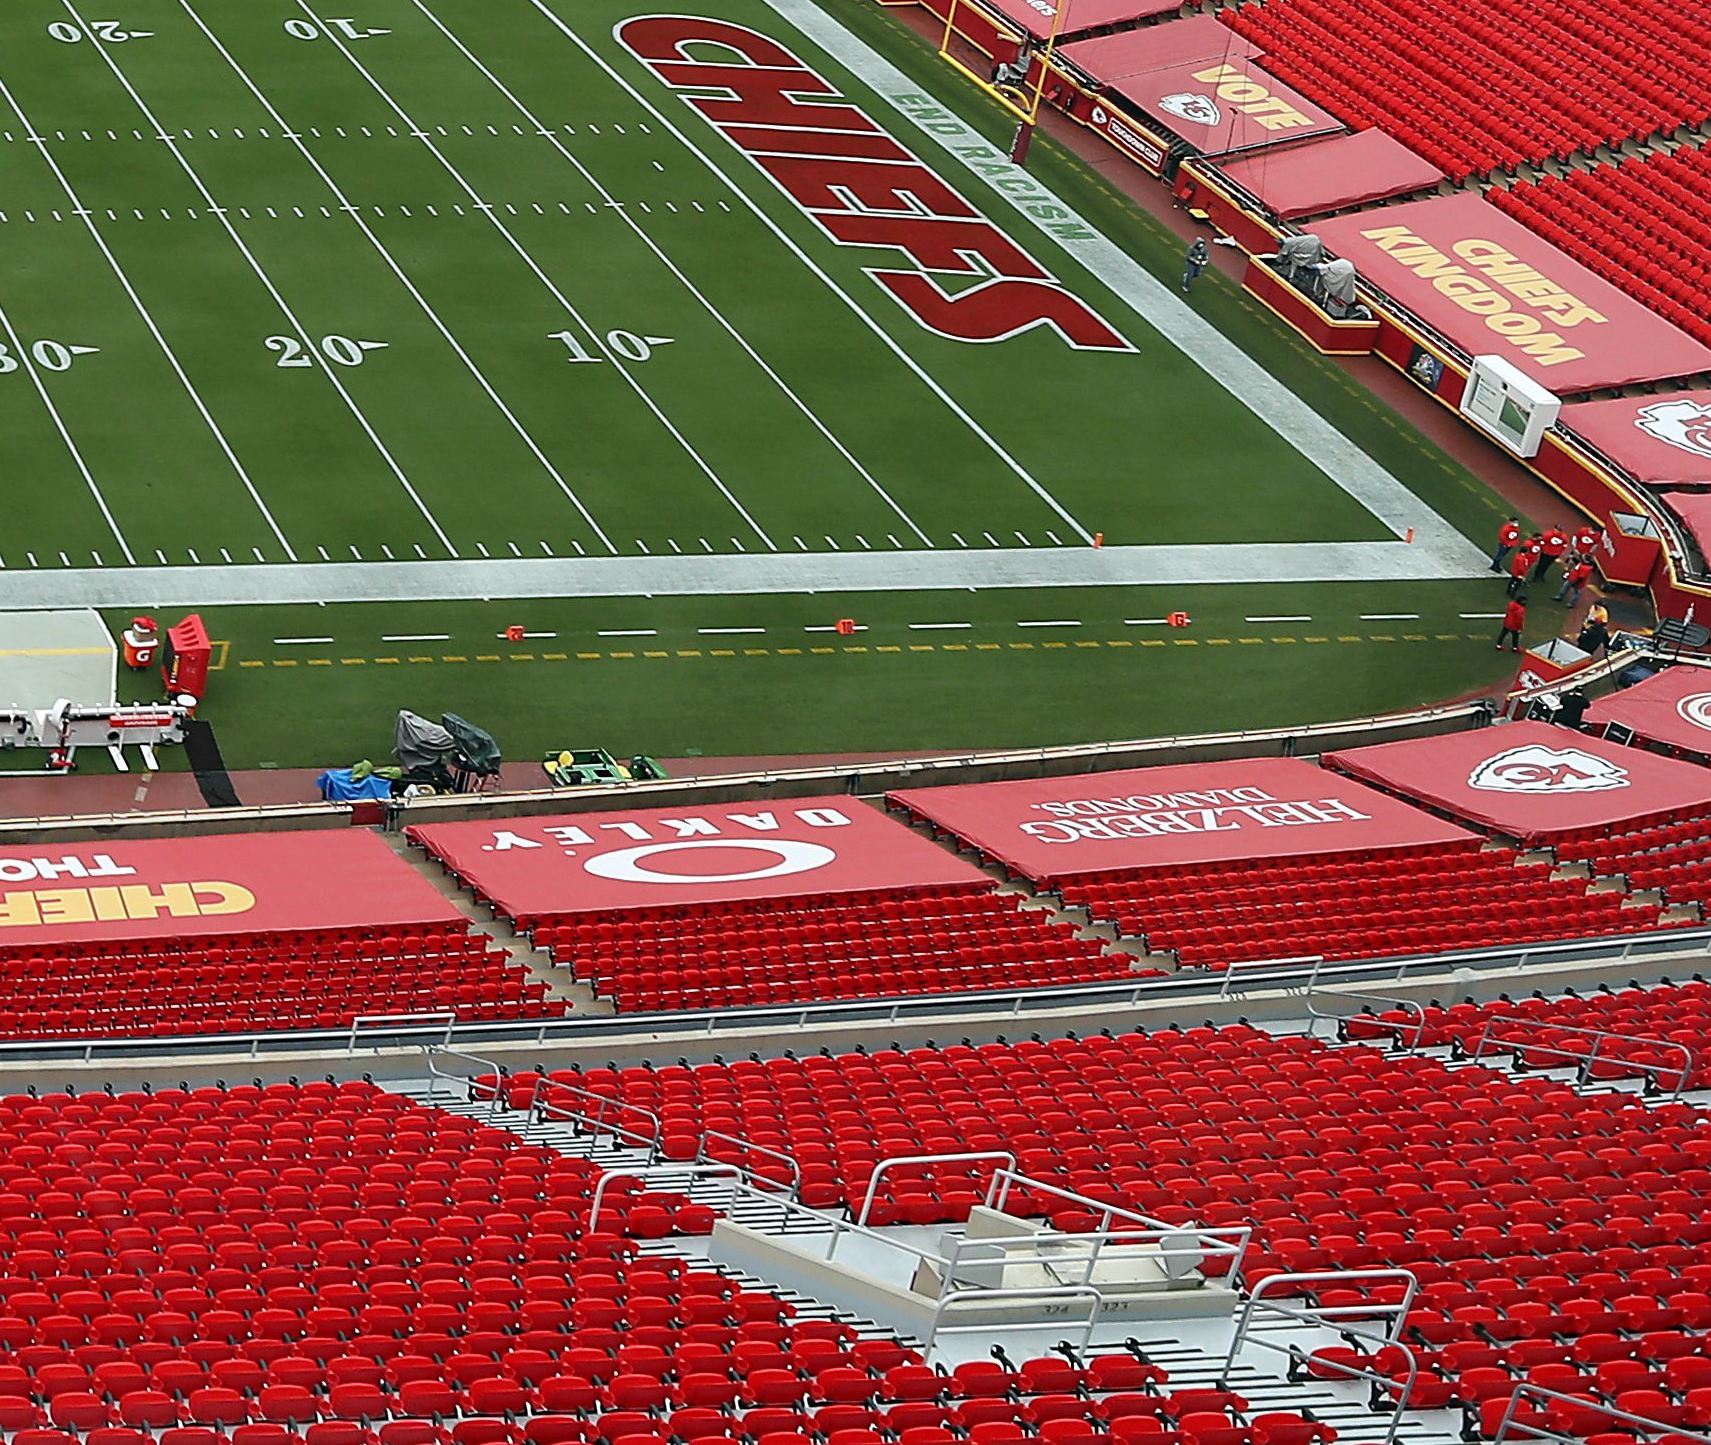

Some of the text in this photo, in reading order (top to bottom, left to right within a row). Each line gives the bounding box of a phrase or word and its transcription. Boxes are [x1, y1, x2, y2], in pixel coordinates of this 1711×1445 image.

[1189, 63, 1316, 131] VOTE
[611, 12, 1141, 354] CHIEFS
[889, 93, 1098, 240] END RACISM
[1358, 225, 1586, 367] KINGDOM
[1450, 238, 1610, 328] CHIEFS
[263, 335, 365, 367] 20
[546, 329, 652, 363] 10
[1019, 797, 1372, 845] HELZBERG
